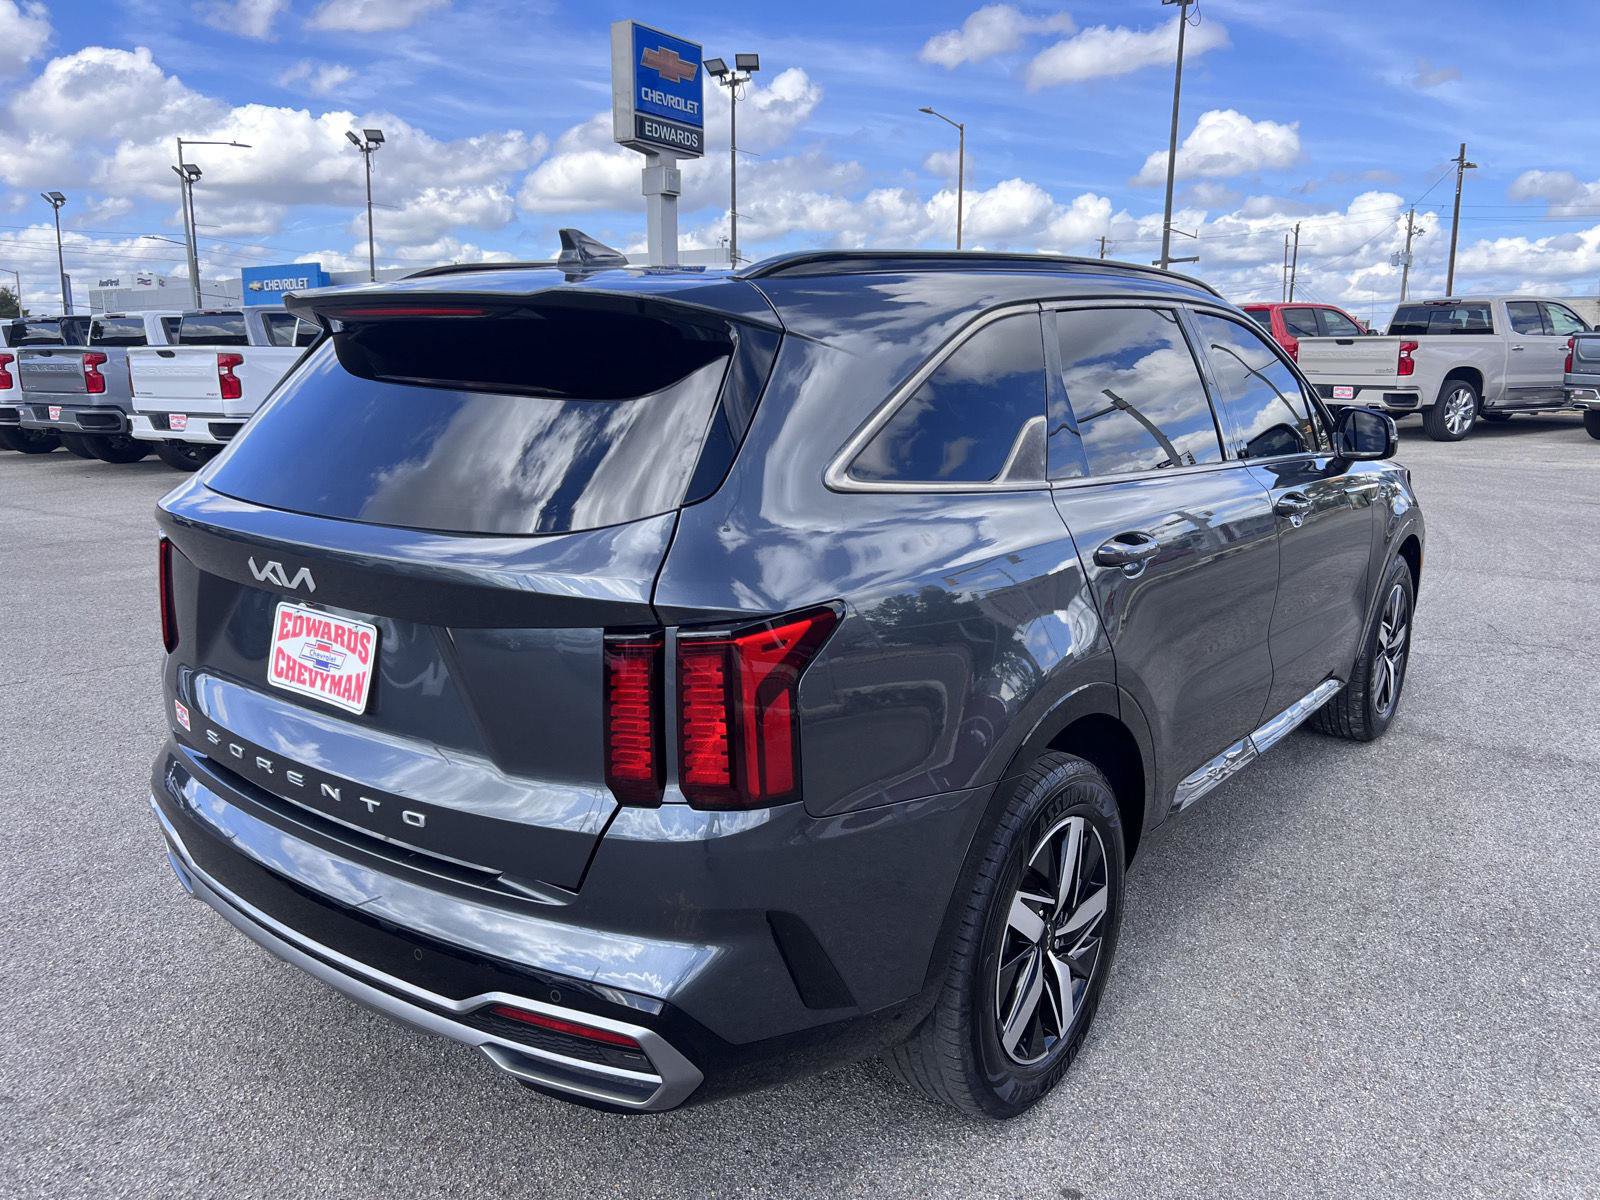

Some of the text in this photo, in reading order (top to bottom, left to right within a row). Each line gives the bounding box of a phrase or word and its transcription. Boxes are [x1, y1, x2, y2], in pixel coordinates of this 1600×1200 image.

[641, 87, 699, 114] CHEVROLET
[644, 121, 698, 147] EDWARDS
[263, 277, 309, 291] CHEVROLET
[247, 556, 317, 593] KIA
[277, 610, 371, 666] EDWARDS
[309, 649, 337, 663] Chevrolet
[273, 646, 367, 704] CHEVYMAN
[205, 729, 428, 828] SORENTO
